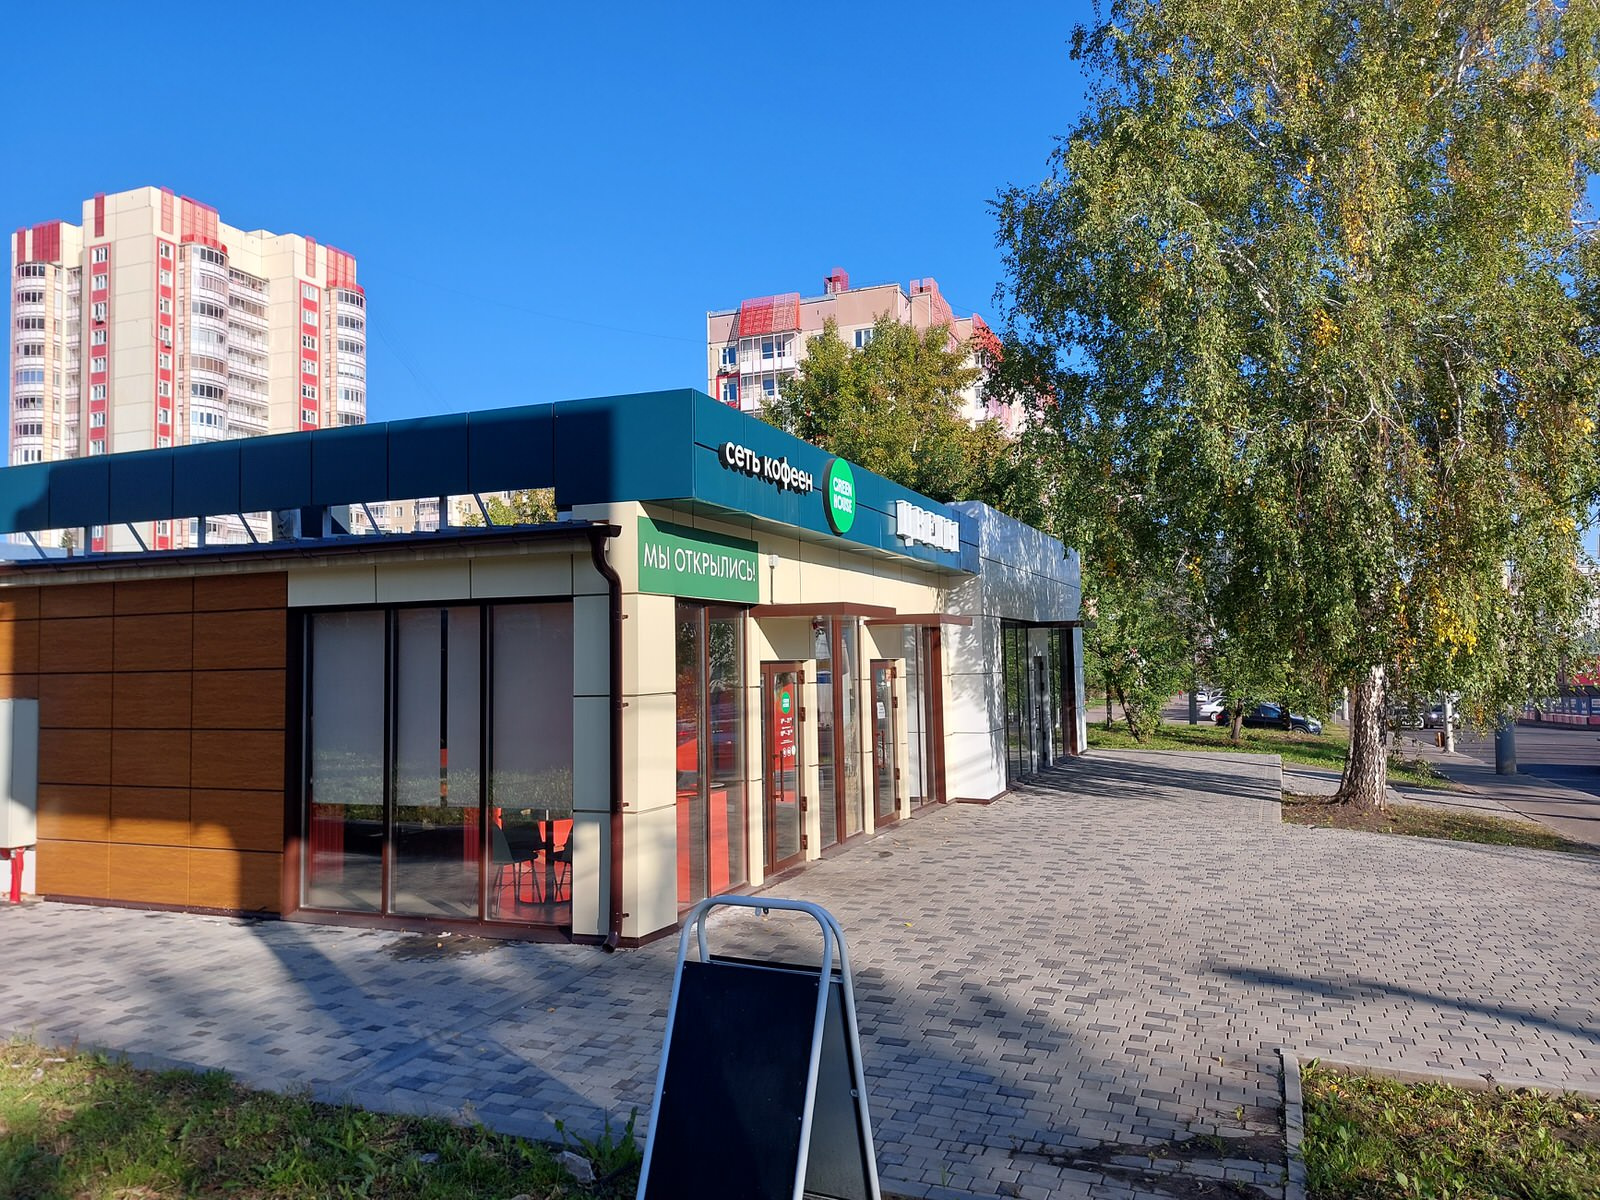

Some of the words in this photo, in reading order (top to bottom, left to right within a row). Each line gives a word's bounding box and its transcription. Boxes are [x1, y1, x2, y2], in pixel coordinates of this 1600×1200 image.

[725, 441, 760, 473] сеть
[764, 456, 813, 492] кофеен
[833, 477, 853, 497] GREEN
[833, 494, 853, 514] HOUSE
[643, 542, 670, 570] МЫ
[674, 548, 756, 582] ОТКРЫЛИСЬ!
